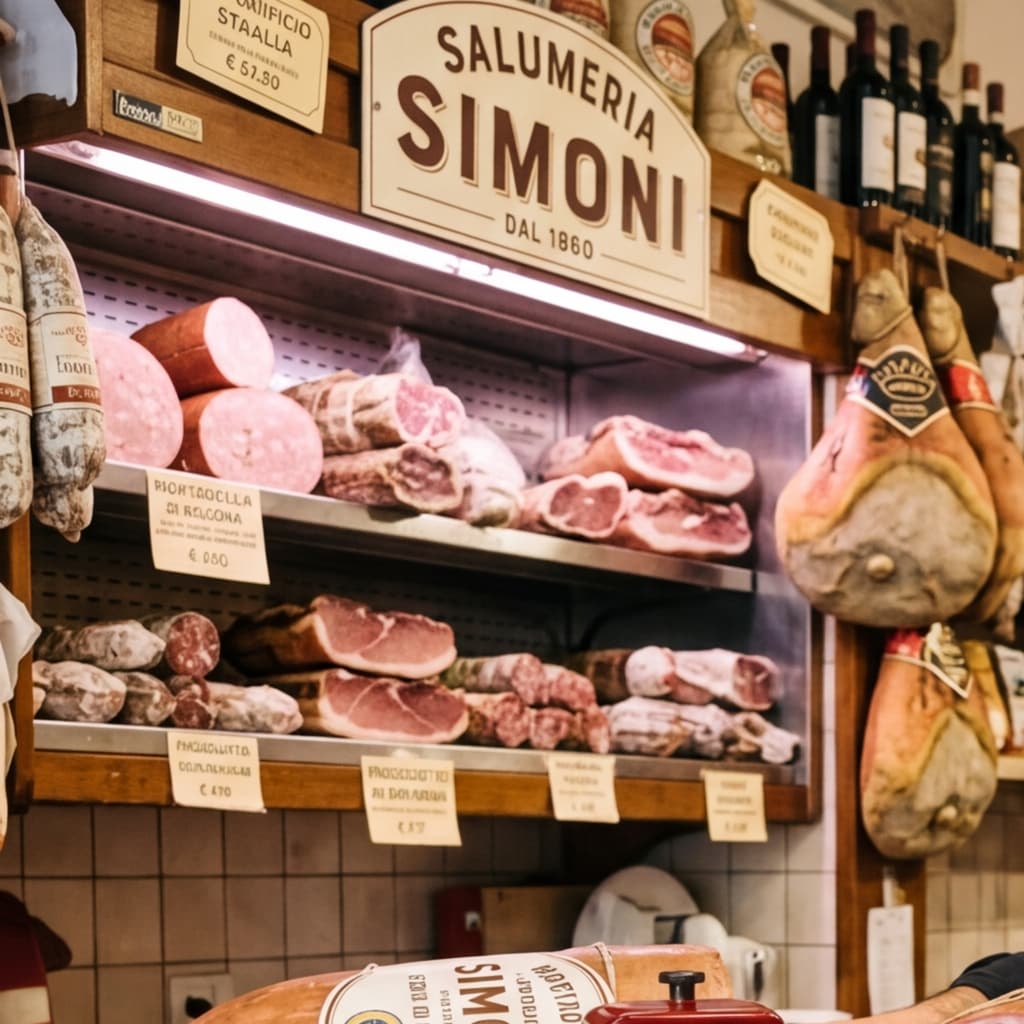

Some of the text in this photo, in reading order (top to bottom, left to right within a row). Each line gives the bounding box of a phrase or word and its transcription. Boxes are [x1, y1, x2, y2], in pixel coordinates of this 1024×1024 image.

[218, 6, 293, 58] STAALLA
[437, 24, 656, 152] SALUMERIA
[397, 74, 685, 255] SIMONI
[505, 213, 594, 260] DAL 1860
